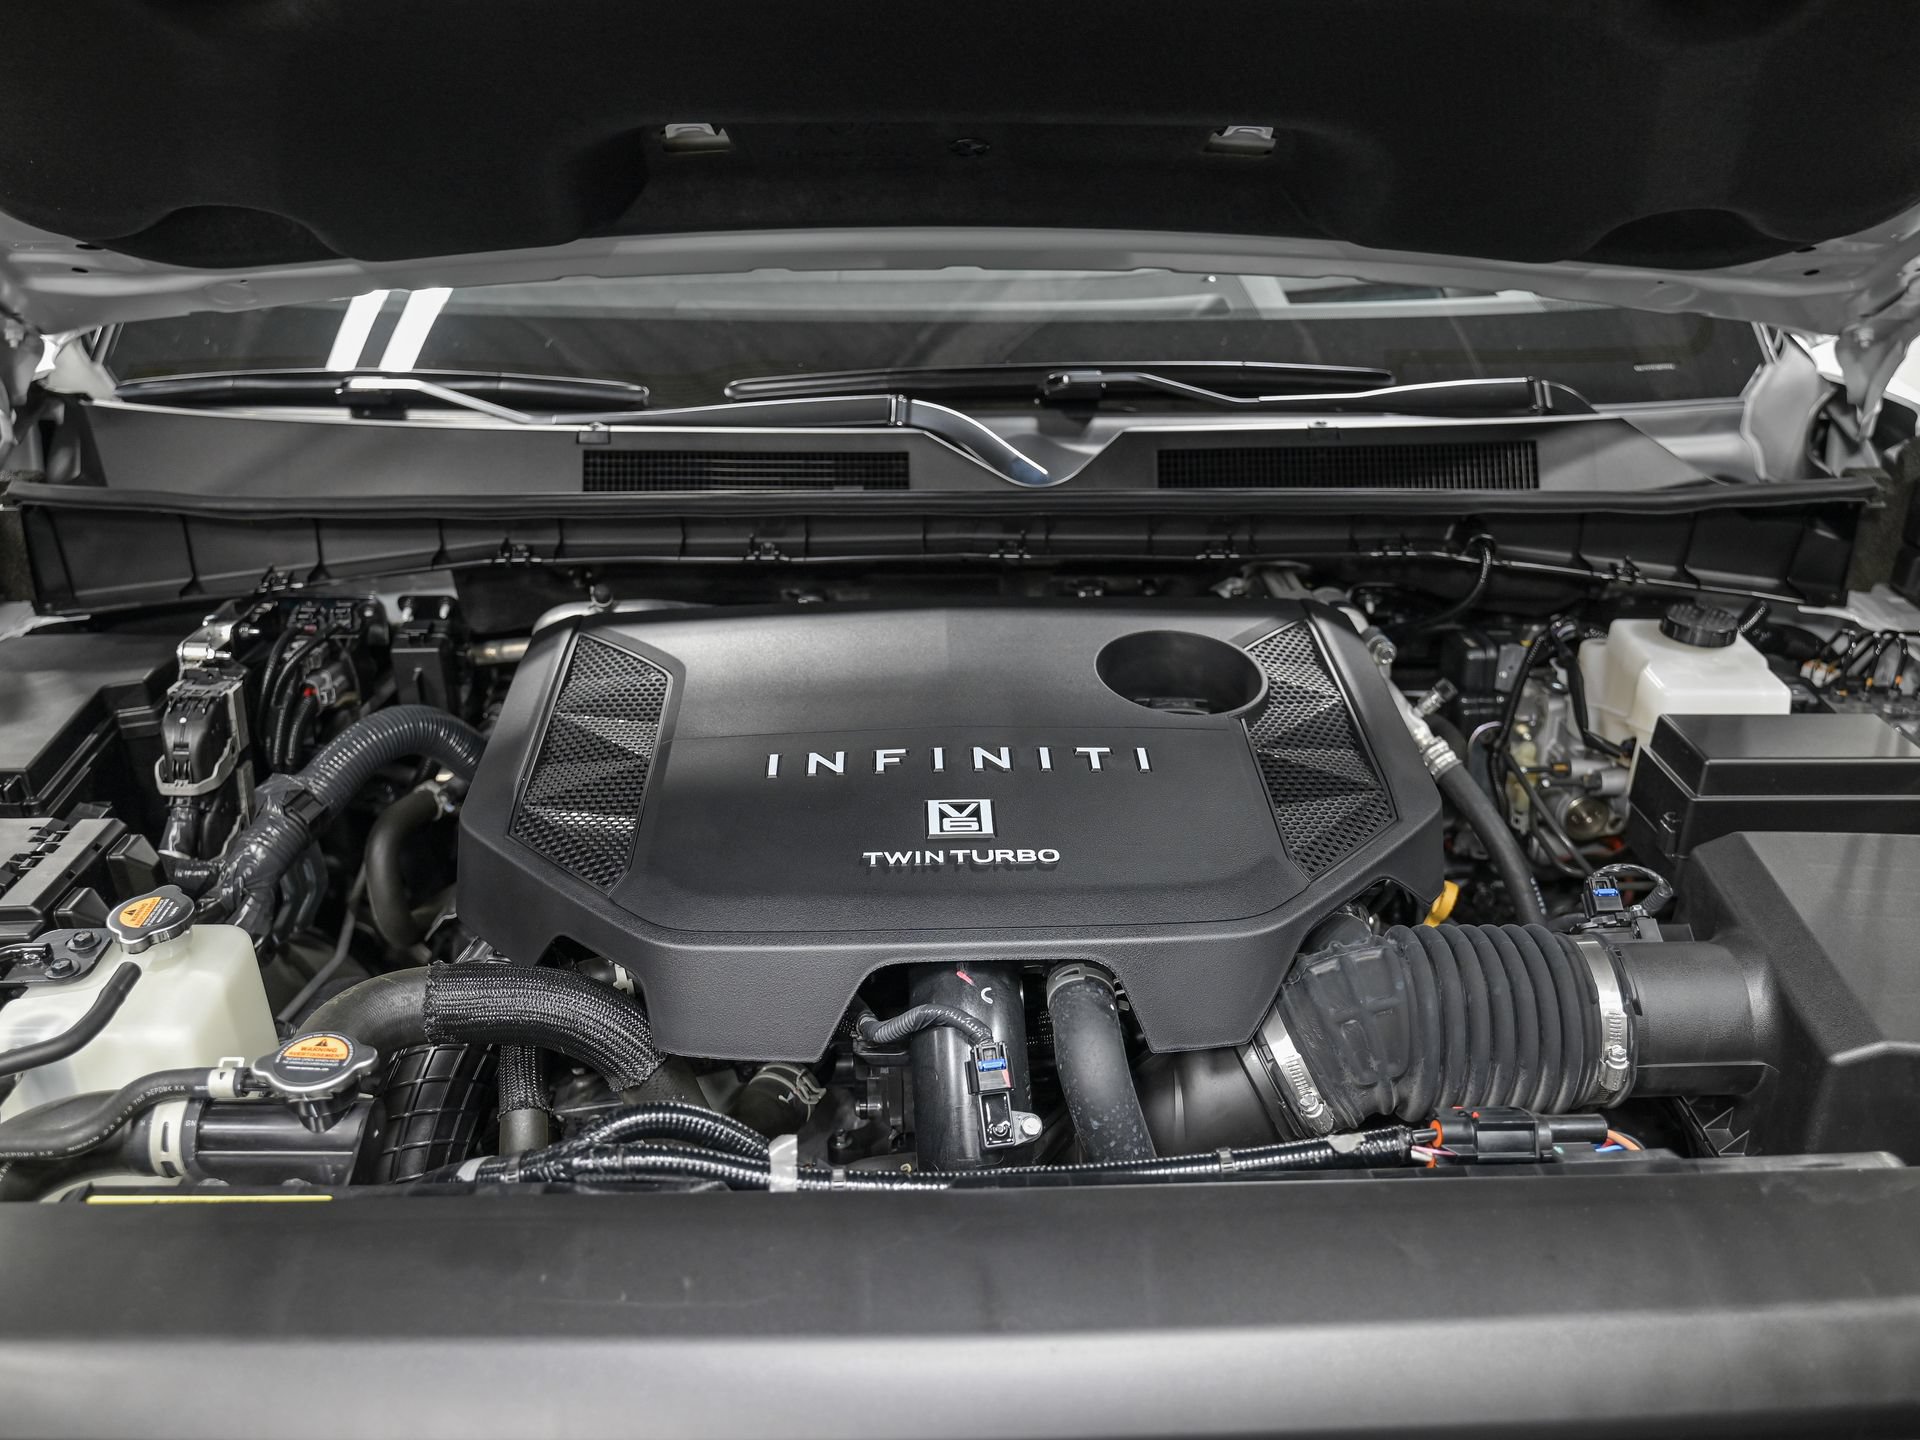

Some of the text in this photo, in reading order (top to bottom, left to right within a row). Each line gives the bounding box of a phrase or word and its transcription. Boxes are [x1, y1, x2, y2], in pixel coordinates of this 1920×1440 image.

[765, 746, 1153, 779] INFINITI
[862, 848, 1061, 868] TWIN TURBO
